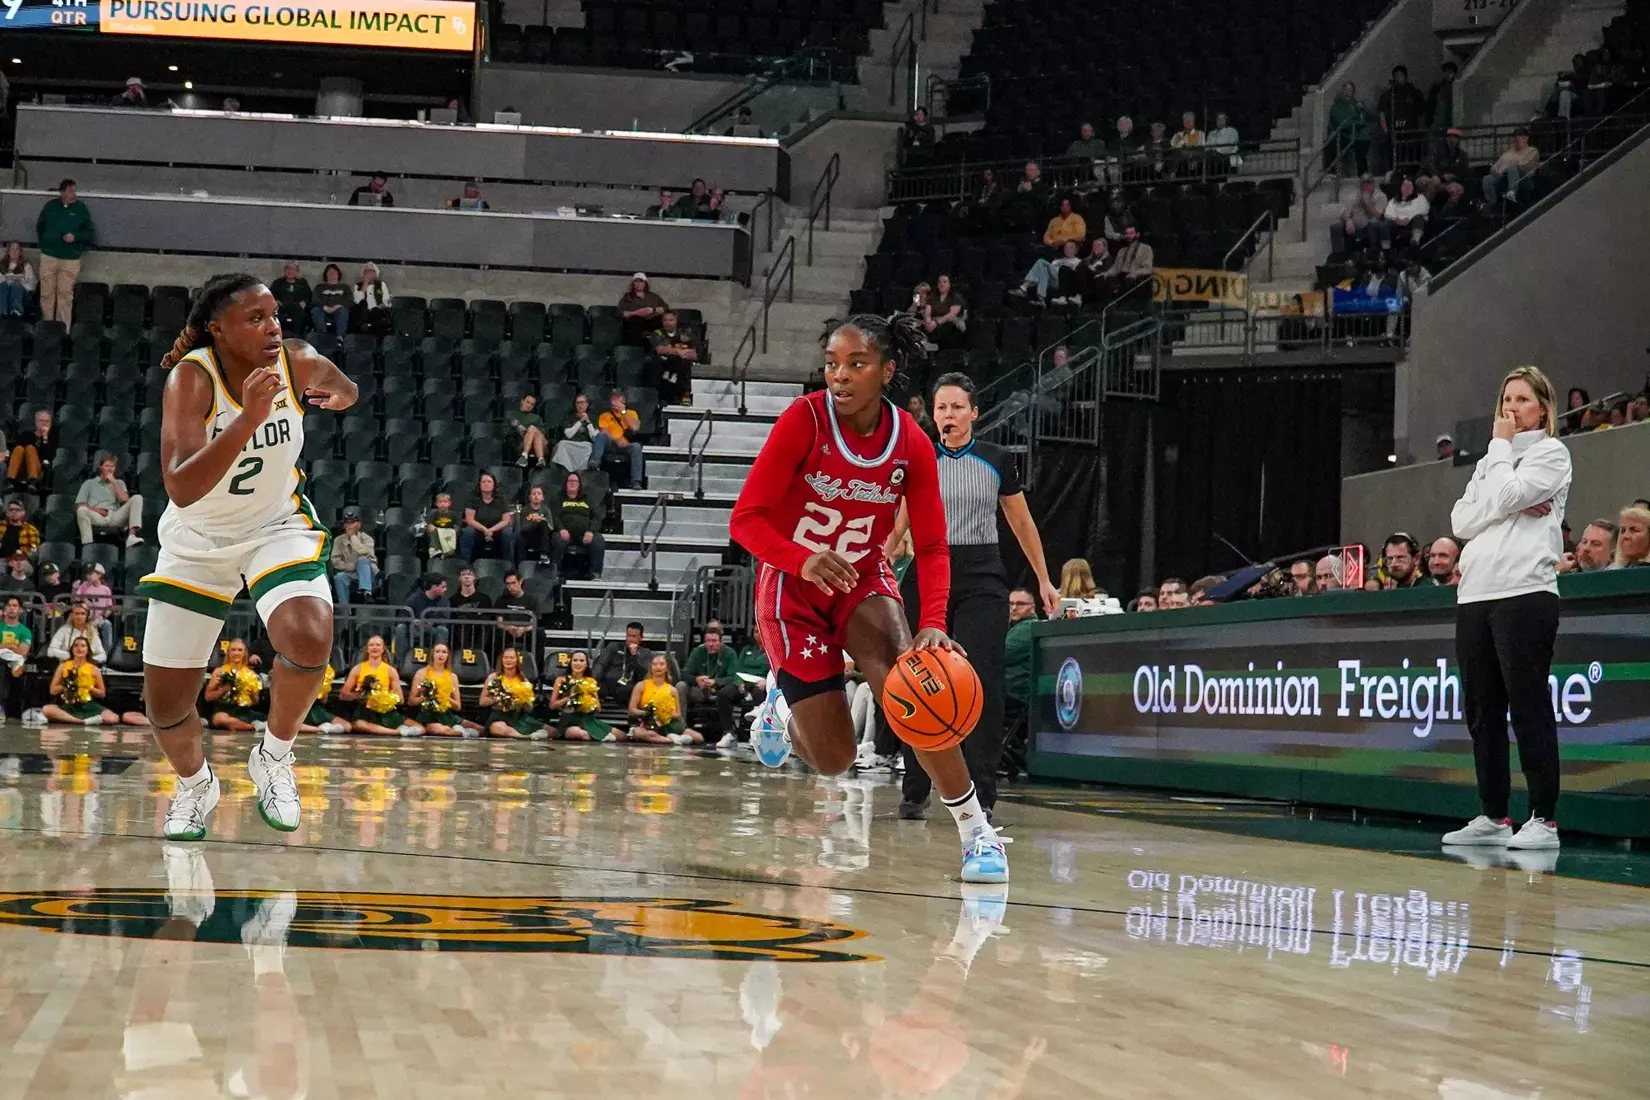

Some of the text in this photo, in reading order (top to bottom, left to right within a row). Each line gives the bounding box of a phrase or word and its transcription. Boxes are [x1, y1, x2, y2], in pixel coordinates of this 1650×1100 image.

[51, 10, 87, 25] QTR
[110, 0, 446, 34] PURSUING GLOBAL IMPACT
[211, 418, 291, 452] LOR
[228, 456, 264, 496] 2
[804, 470, 843, 502] Lady
[792, 502, 876, 564] 22
[904, 654, 941, 697] ELITE
[1133, 665, 1177, 713] Old
[1183, 661, 1322, 716] Dominion
[1337, 658, 1463, 738] Freigh
